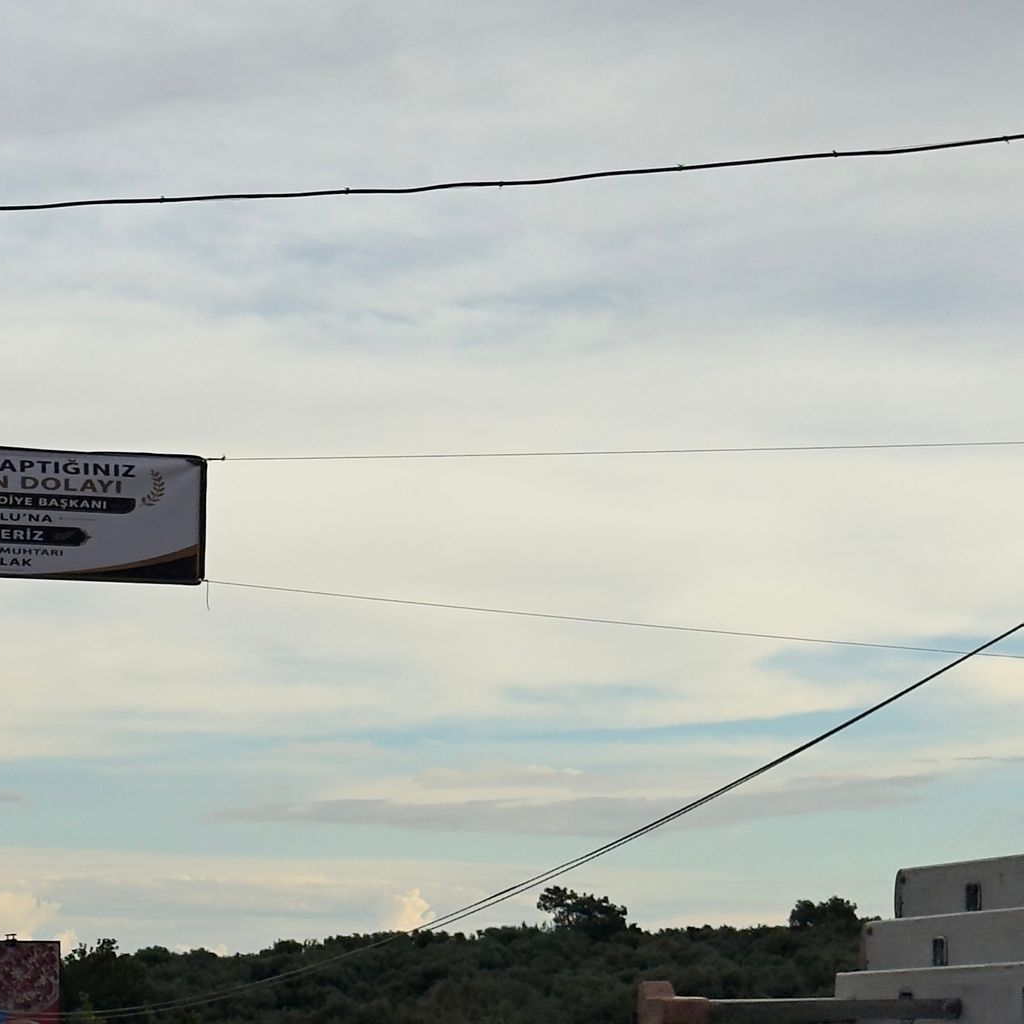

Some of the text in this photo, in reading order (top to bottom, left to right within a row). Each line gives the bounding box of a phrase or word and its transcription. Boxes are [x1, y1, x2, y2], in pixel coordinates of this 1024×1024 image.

[21, 476, 123, 494] DOLAYI
[38, 498, 107, 510] BAŞKANI
[0, 547, 63, 556] MUHTARI
